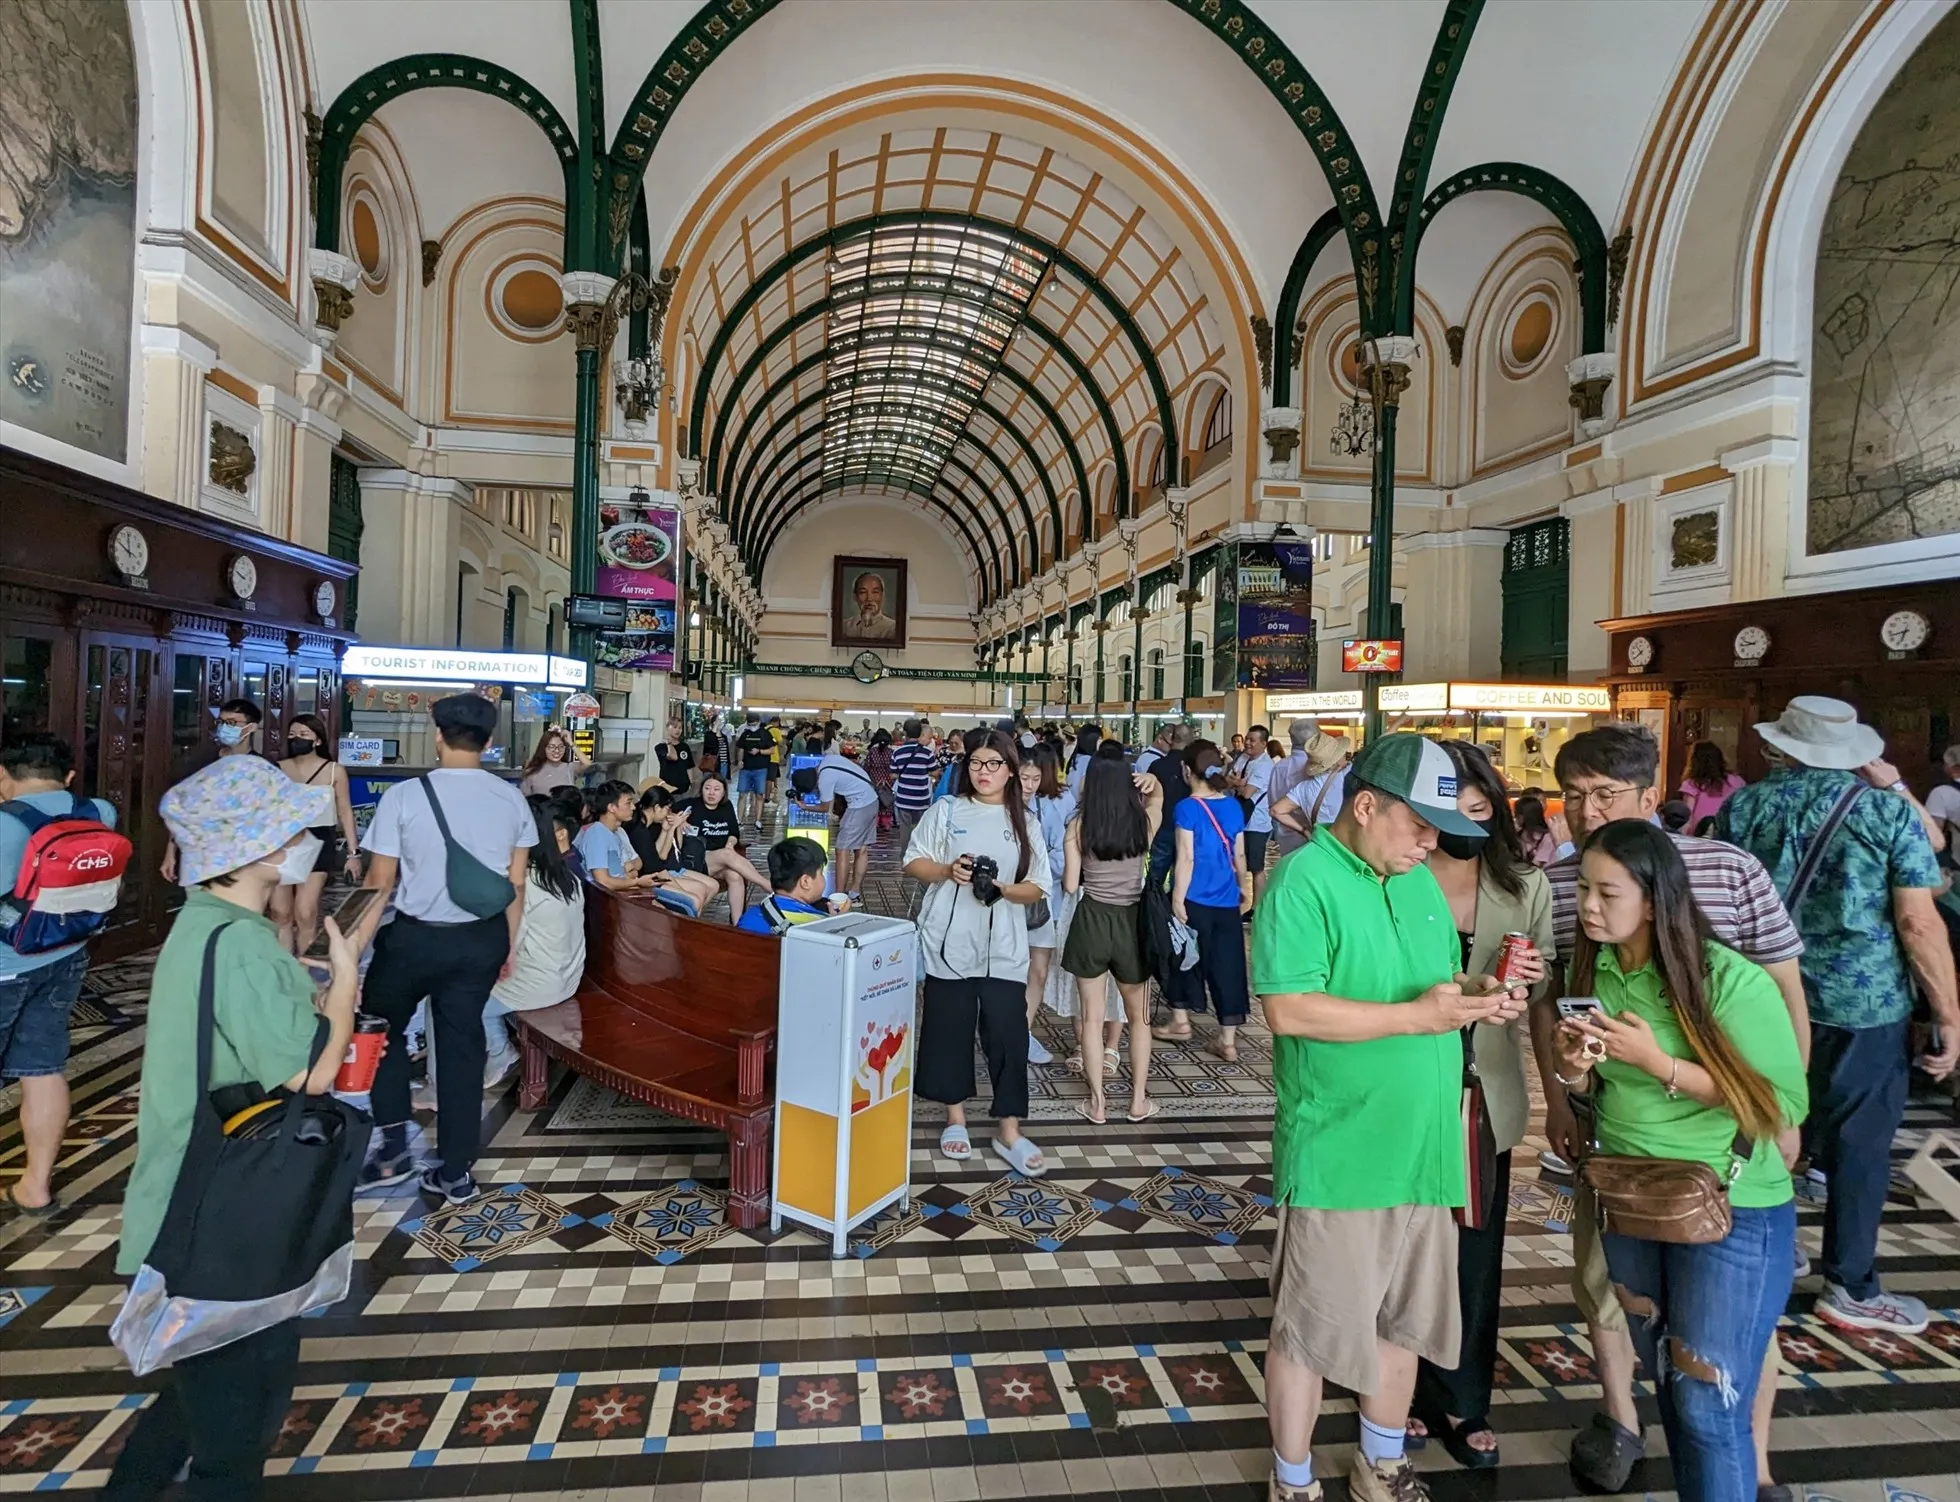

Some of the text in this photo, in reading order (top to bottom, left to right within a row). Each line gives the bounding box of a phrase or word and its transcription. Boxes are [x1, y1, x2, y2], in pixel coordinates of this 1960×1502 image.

[362, 655, 539, 674] TOURIST INFORMATION
[756, 664, 779, 672] NHANH
[1270, 698, 1283, 708] BEST
[1318, 695, 1331, 706] THE
[1332, 694, 1358, 706] WORLD
[1381, 688, 1409, 701] Coffee
[1475, 689, 1537, 704] COFFEE
[1542, 691, 1572, 705] AND
[339, 741, 380, 750] SIM CARD
[77, 856, 109, 870] CMS
